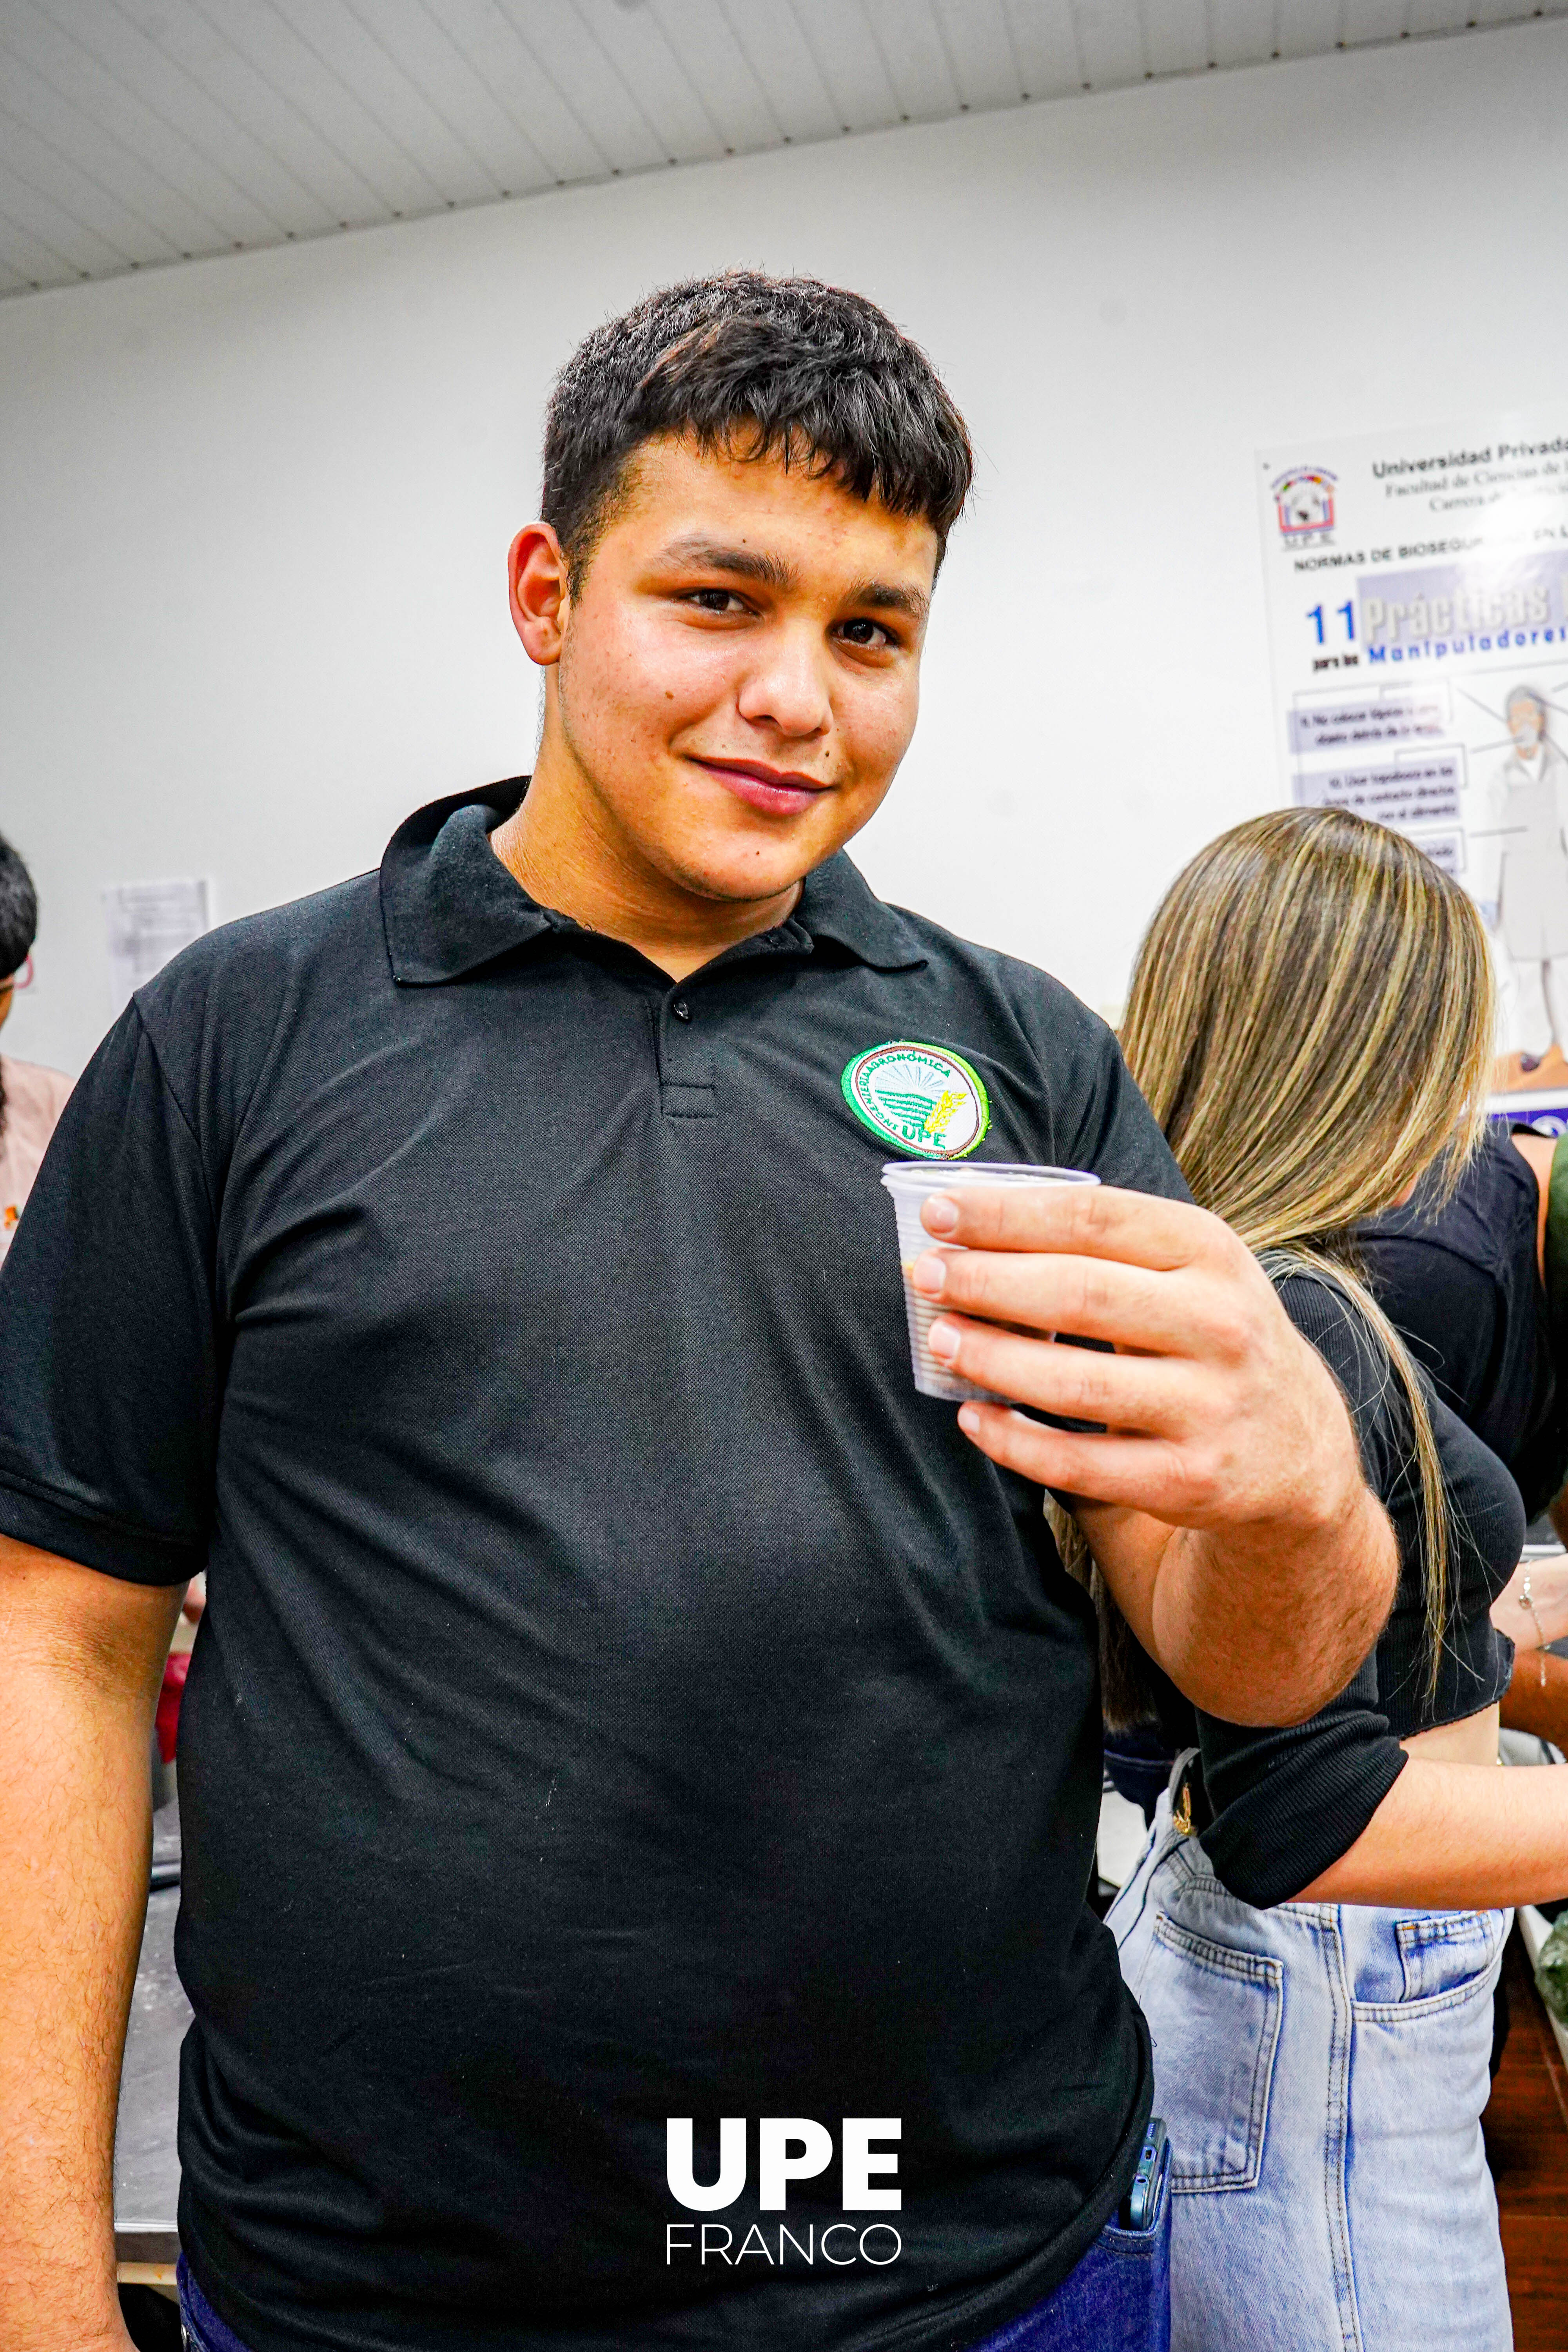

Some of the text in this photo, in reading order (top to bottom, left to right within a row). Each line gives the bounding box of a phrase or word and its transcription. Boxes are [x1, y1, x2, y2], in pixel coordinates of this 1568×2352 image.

[1372, 446, 1491, 478] Universidad
[1294, 552, 1365, 571] NORMAS
[1372, 548, 1391, 562] DE
[866, 1051, 950, 1078] AGRONÓMICA
[902, 1125, 947, 1149] UPE
